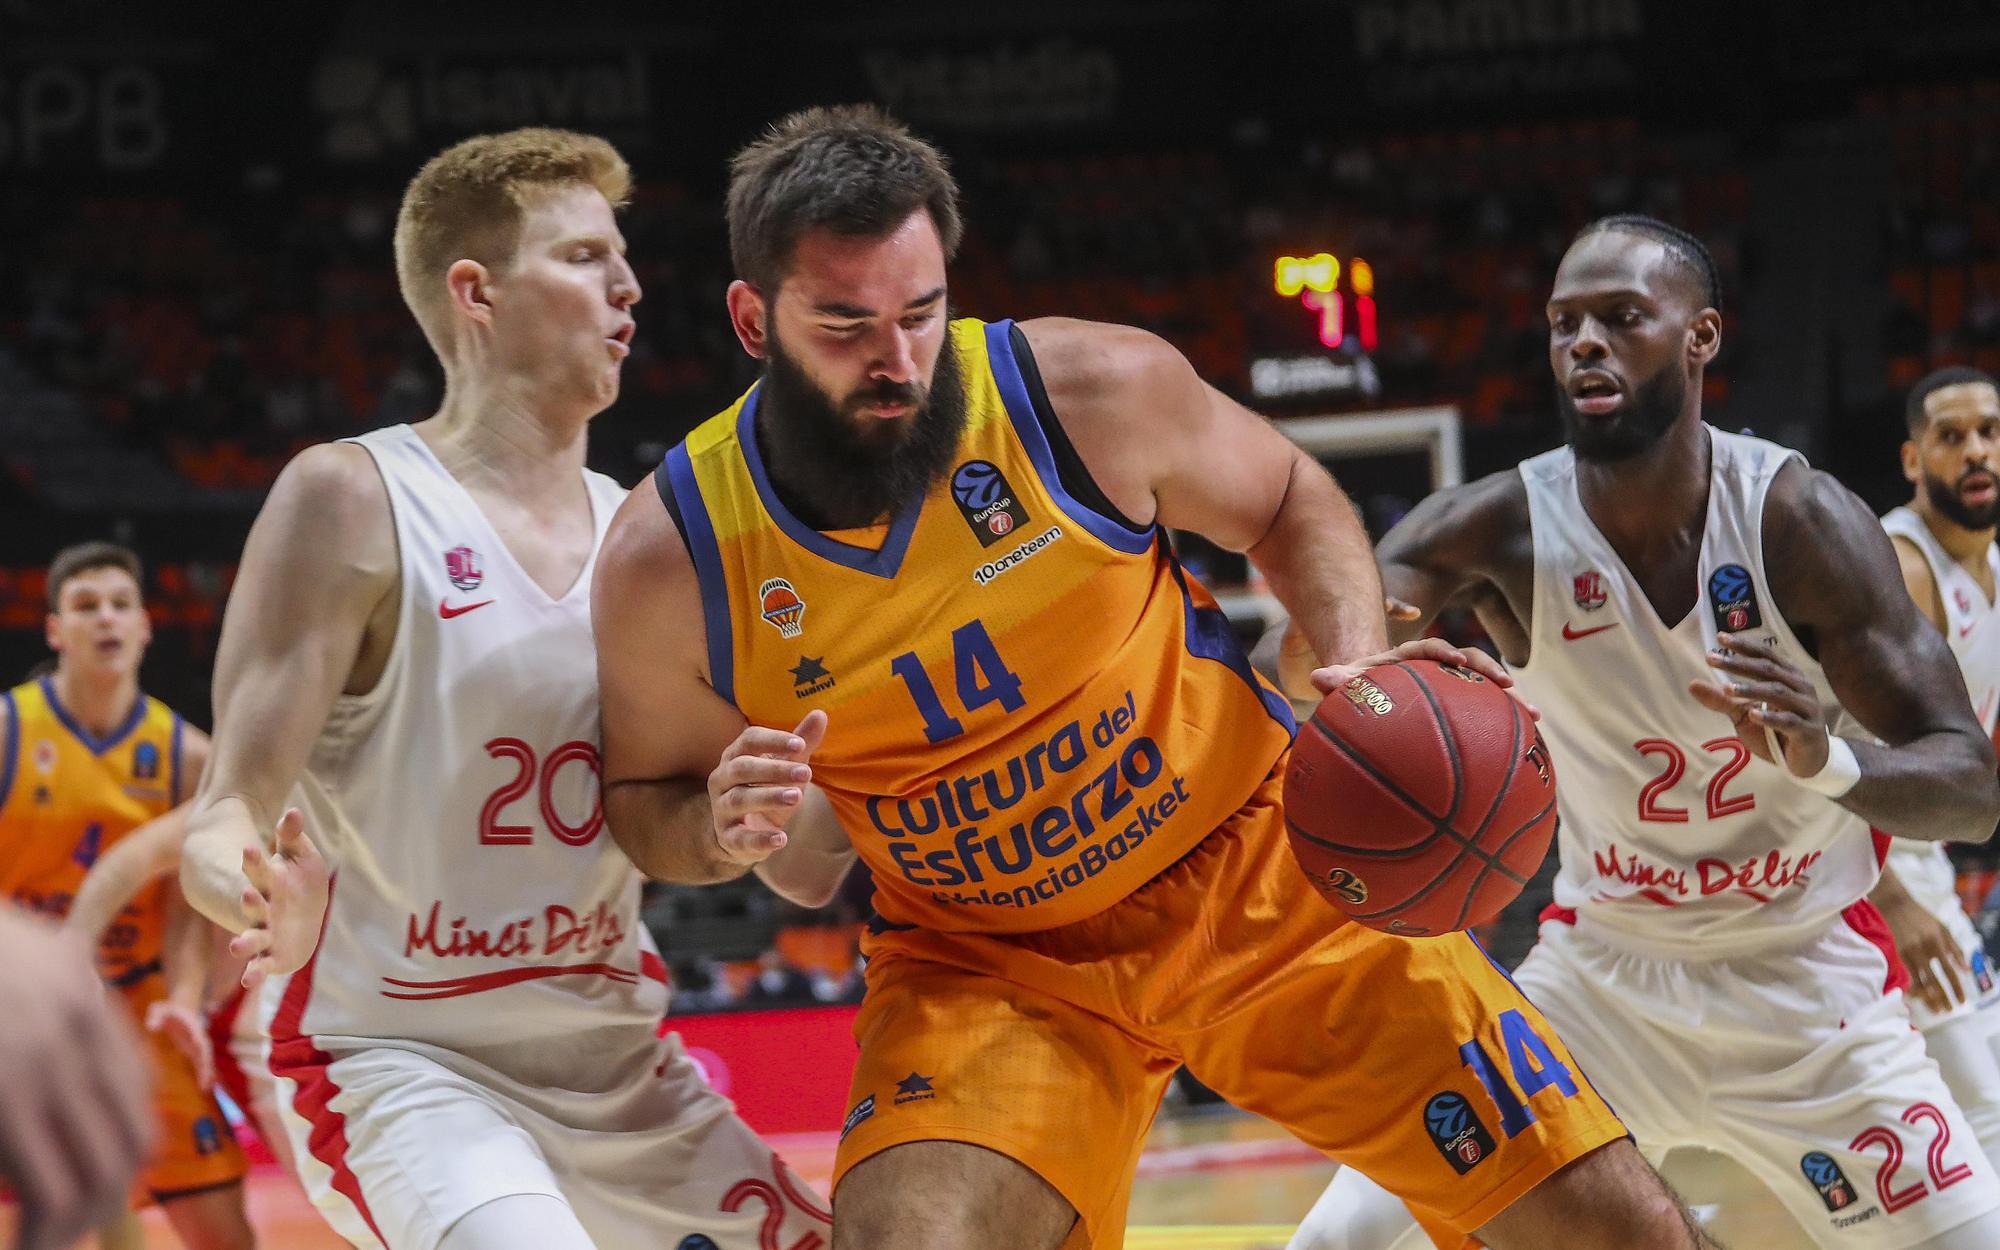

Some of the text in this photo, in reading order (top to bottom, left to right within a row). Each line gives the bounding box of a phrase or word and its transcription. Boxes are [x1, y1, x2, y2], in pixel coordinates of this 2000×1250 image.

[0, 66, 168, 168] PB
[973, 497, 1011, 523] EuroCup
[974, 527, 1061, 583] 10oneteam
[891, 618, 1027, 744] 14
[478, 737, 605, 847] 20
[865, 689, 1137, 838] Cultura del
[887, 736, 1163, 886] Esfuerzo
[1633, 735, 1756, 823] 22
[1595, 843, 1689, 895] Minci
[404, 900, 534, 958] Minci
[1458, 1007, 1579, 1141] 14
[1848, 1101, 1974, 1214] 22
